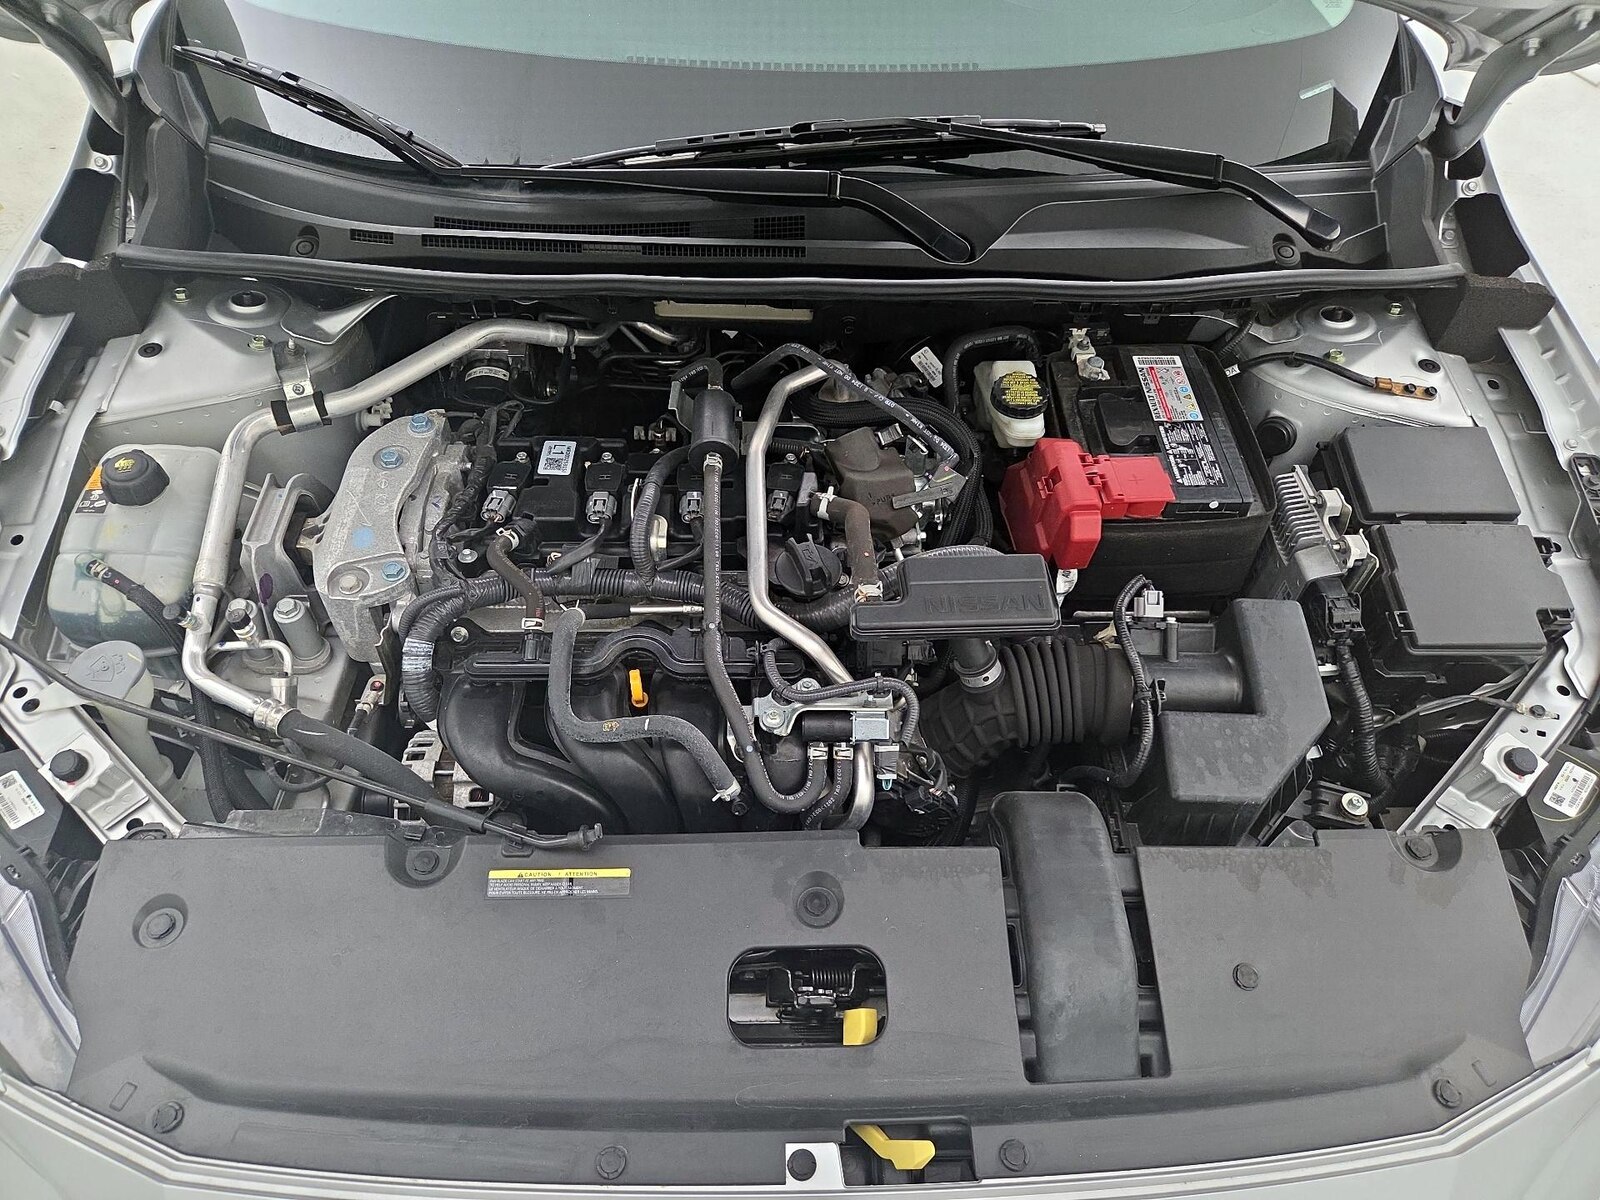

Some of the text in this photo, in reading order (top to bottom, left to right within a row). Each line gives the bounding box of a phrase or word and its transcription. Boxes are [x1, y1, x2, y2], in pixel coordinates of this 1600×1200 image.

[1138, 367, 1152, 393] NISSAN
[552, 444, 567, 455] L1
[924, 592, 1047, 613] NISSAN
